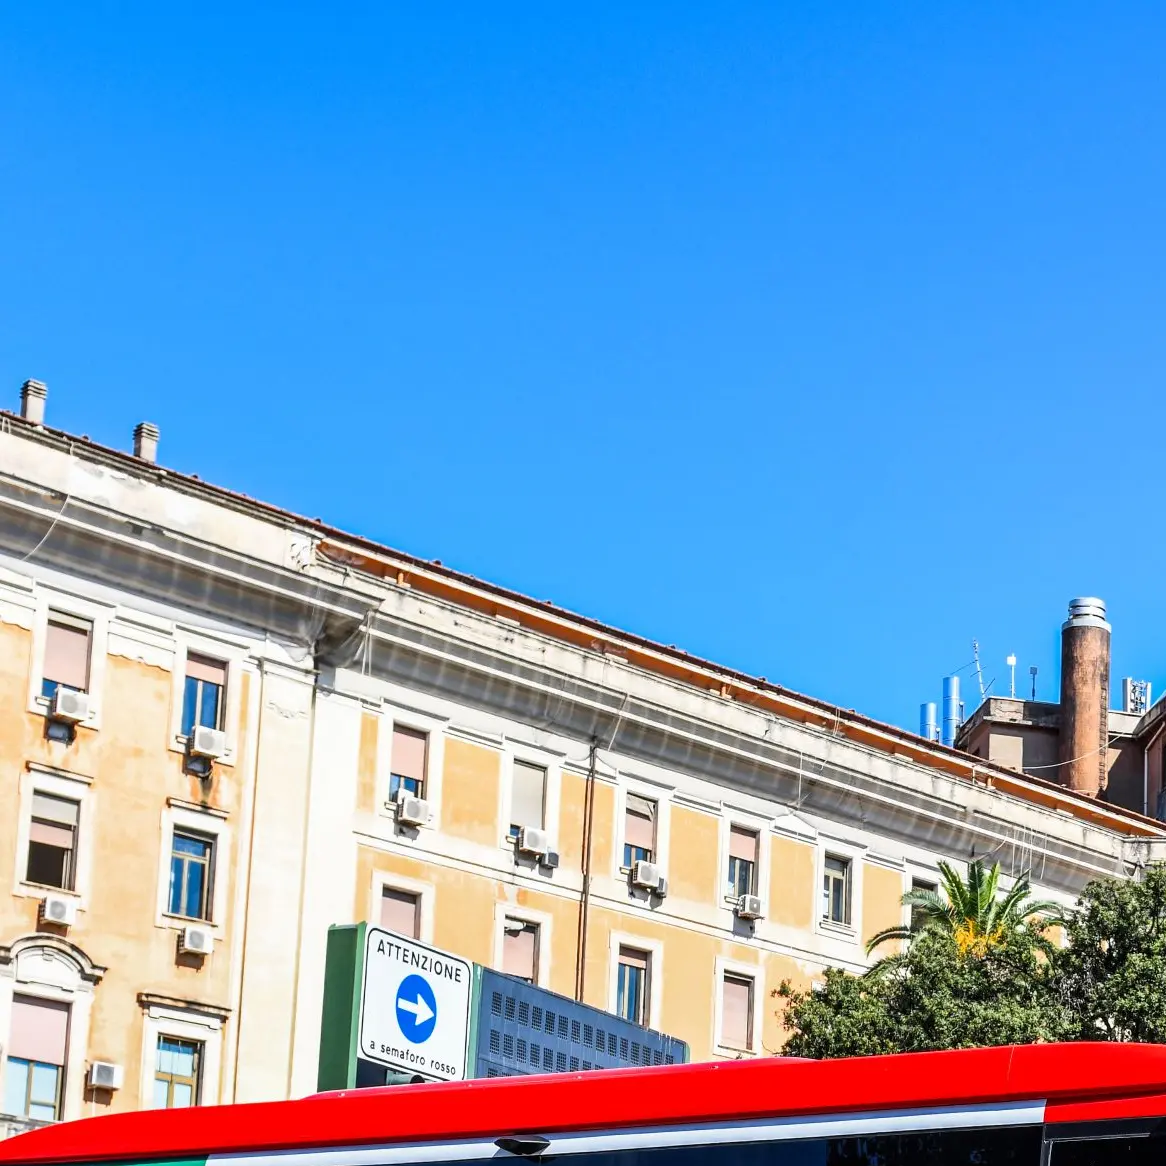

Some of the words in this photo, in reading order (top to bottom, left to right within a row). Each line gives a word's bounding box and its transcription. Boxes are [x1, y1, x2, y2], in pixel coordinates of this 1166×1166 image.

[377, 939, 461, 983] ATTENZIONE
[370, 1041, 375, 1050] a
[381, 1044, 426, 1066] semaforo
[431, 1060, 456, 1075] rosso
